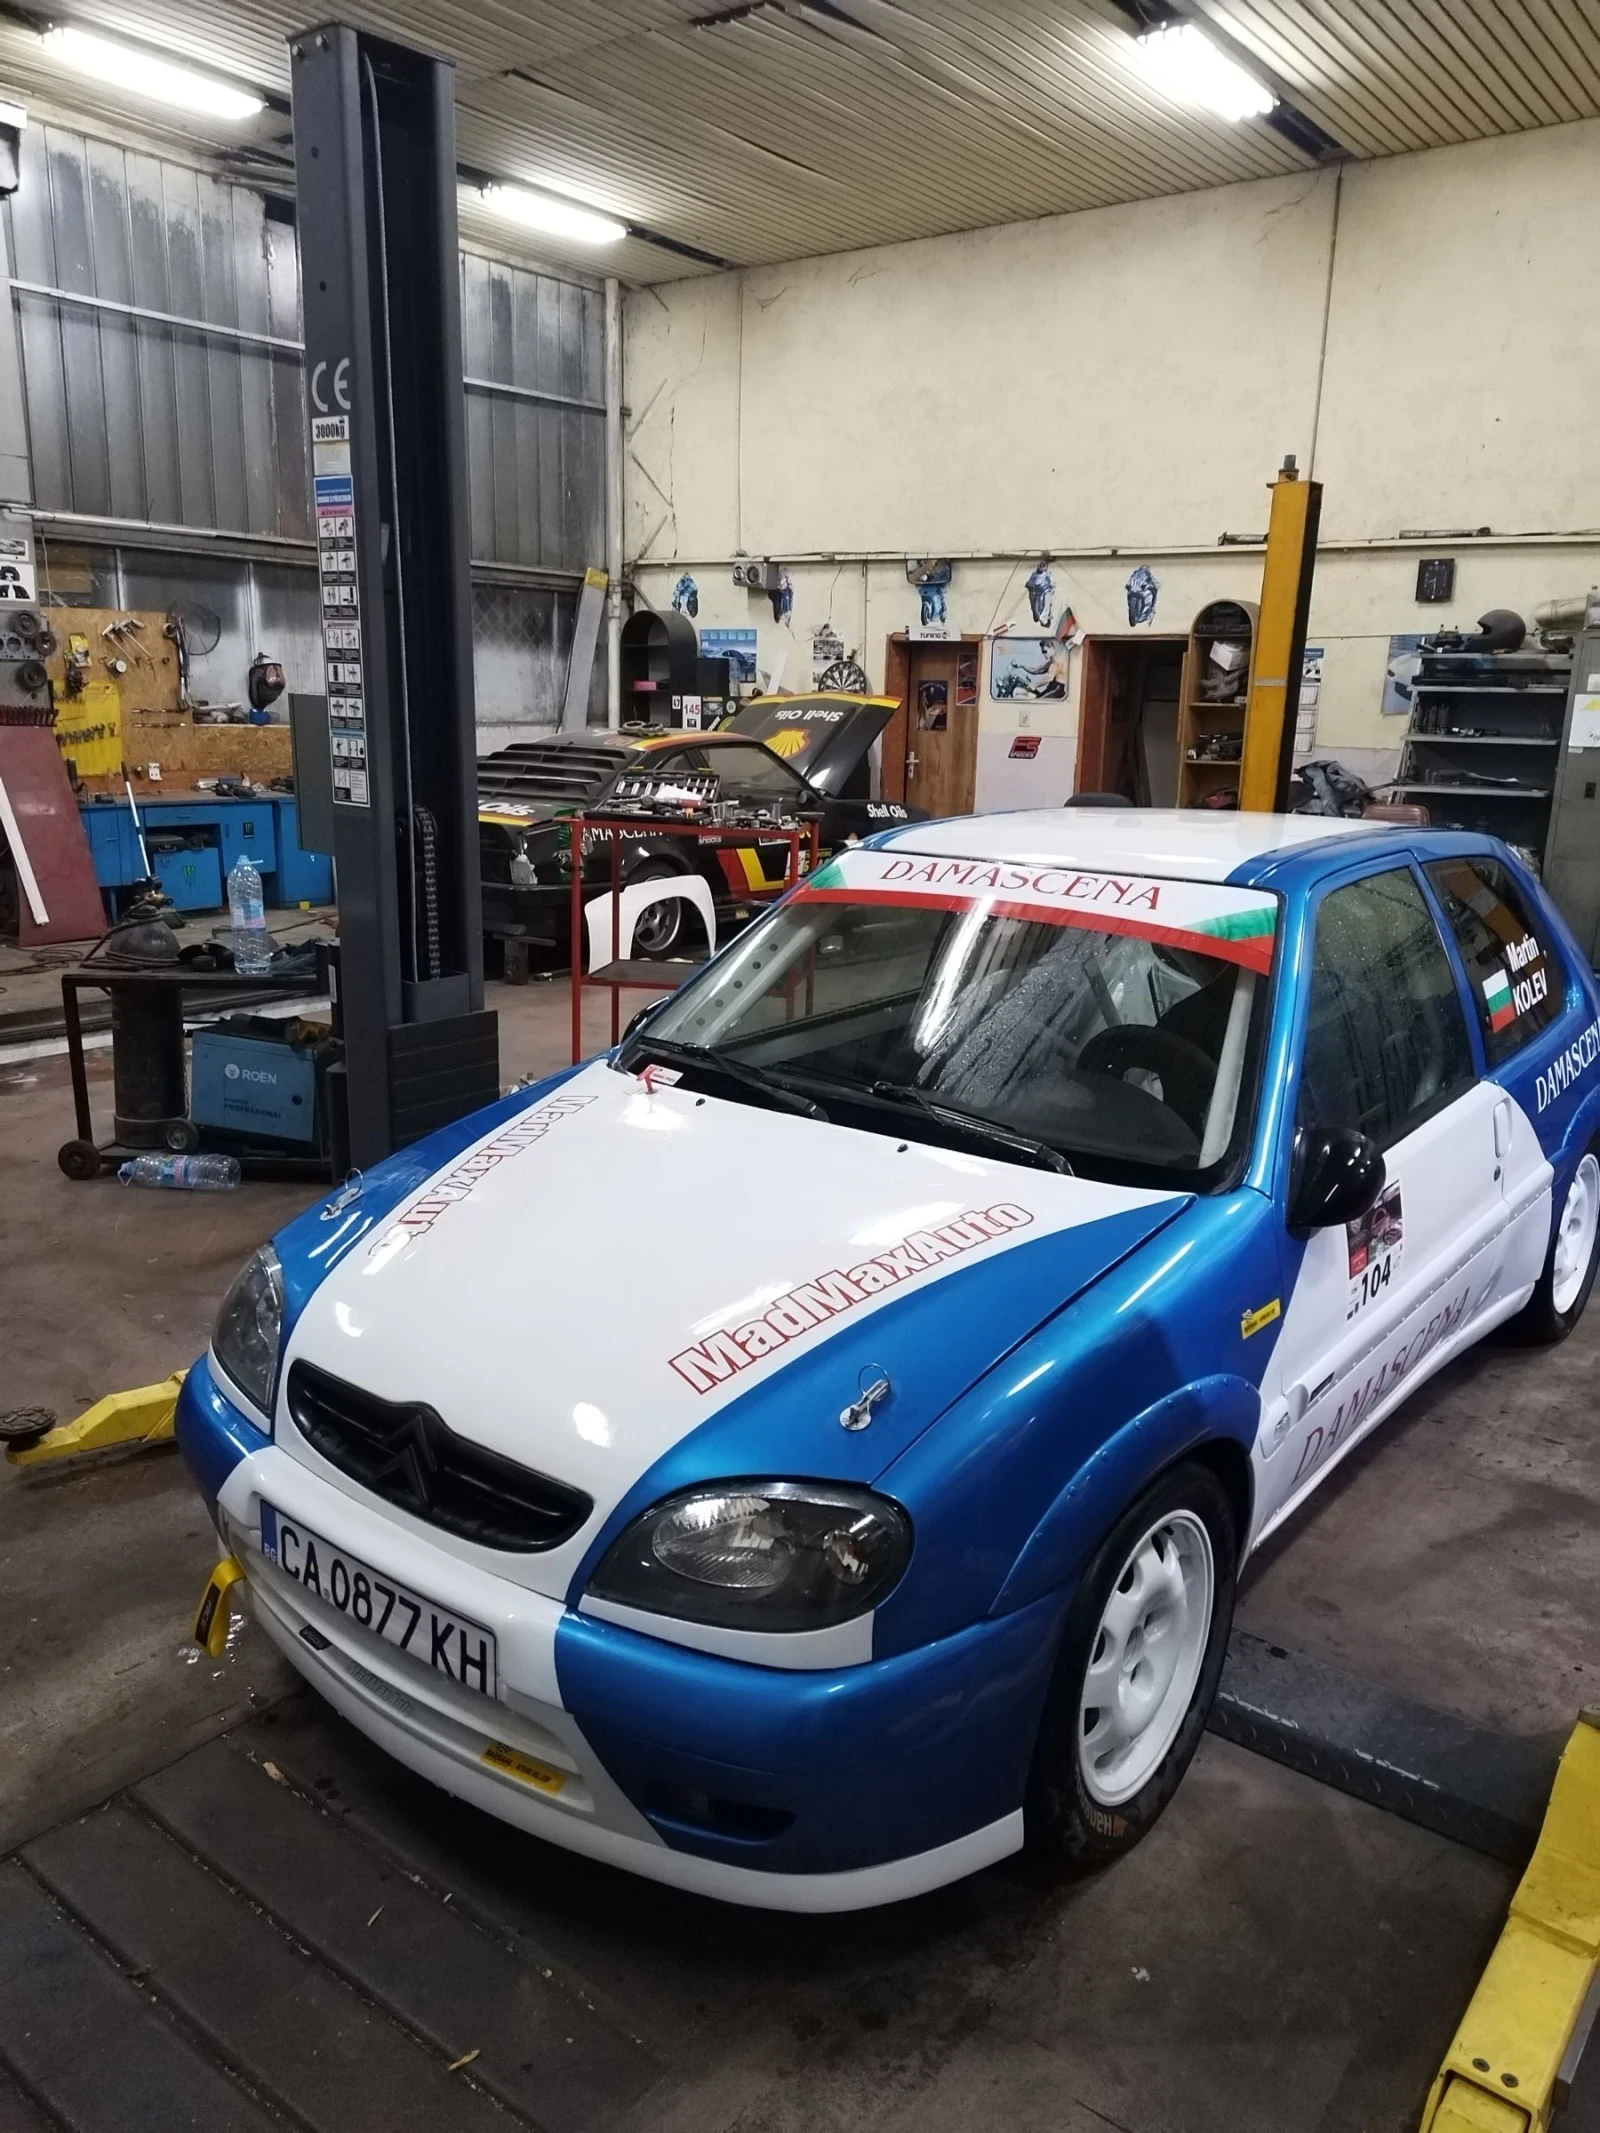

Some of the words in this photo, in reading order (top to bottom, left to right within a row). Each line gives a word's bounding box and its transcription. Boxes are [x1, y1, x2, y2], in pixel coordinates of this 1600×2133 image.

[315, 422, 345, 439] 3000kg
[684, 704, 700, 715] 145
[775, 710, 803, 720] Oils
[803, 710, 844, 721] Shell
[867, 803, 890, 818] Shell
[890, 804, 907, 818] Oils
[881, 860, 1162, 911] DAMASCENA
[1506, 933, 1540, 973] Martin
[1513, 968, 1548, 1016] KOLEV
[1535, 1015, 1600, 1115] DAMASCEN
[1361, 1253, 1391, 1306] 104
[668, 1203, 1035, 1395] MadMaxAuto
[264, 1543, 277, 1563] BG
